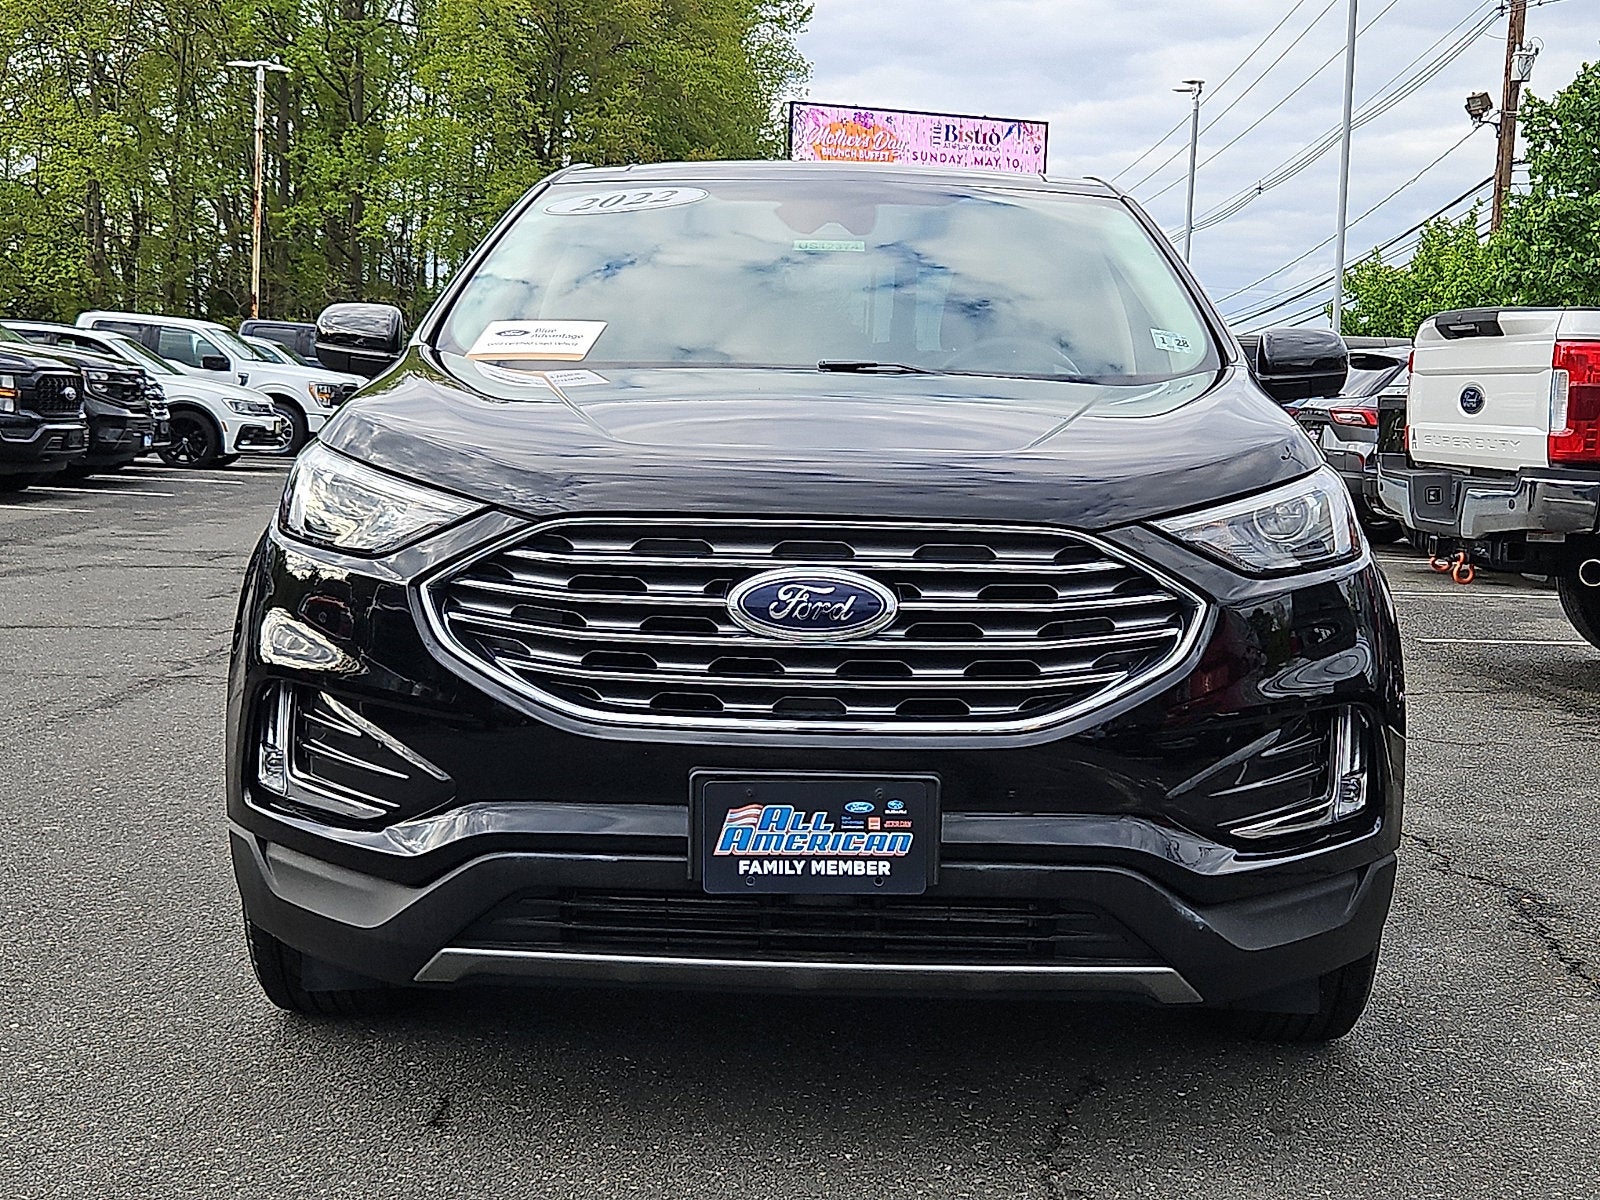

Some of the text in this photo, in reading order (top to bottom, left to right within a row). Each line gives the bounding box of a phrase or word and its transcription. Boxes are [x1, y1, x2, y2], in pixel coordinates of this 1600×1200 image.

[821, 147, 890, 161] BRUNCH BUFFET
[974, 156, 1001, 168] MAY
[570, 190, 679, 212] 2022
[1160, 336, 1189, 347] 1 28
[1424, 434, 1521, 452] SUPER DUTY
[768, 583, 857, 621] Ford
[738, 860, 891, 876] FAMILY MEMBER
